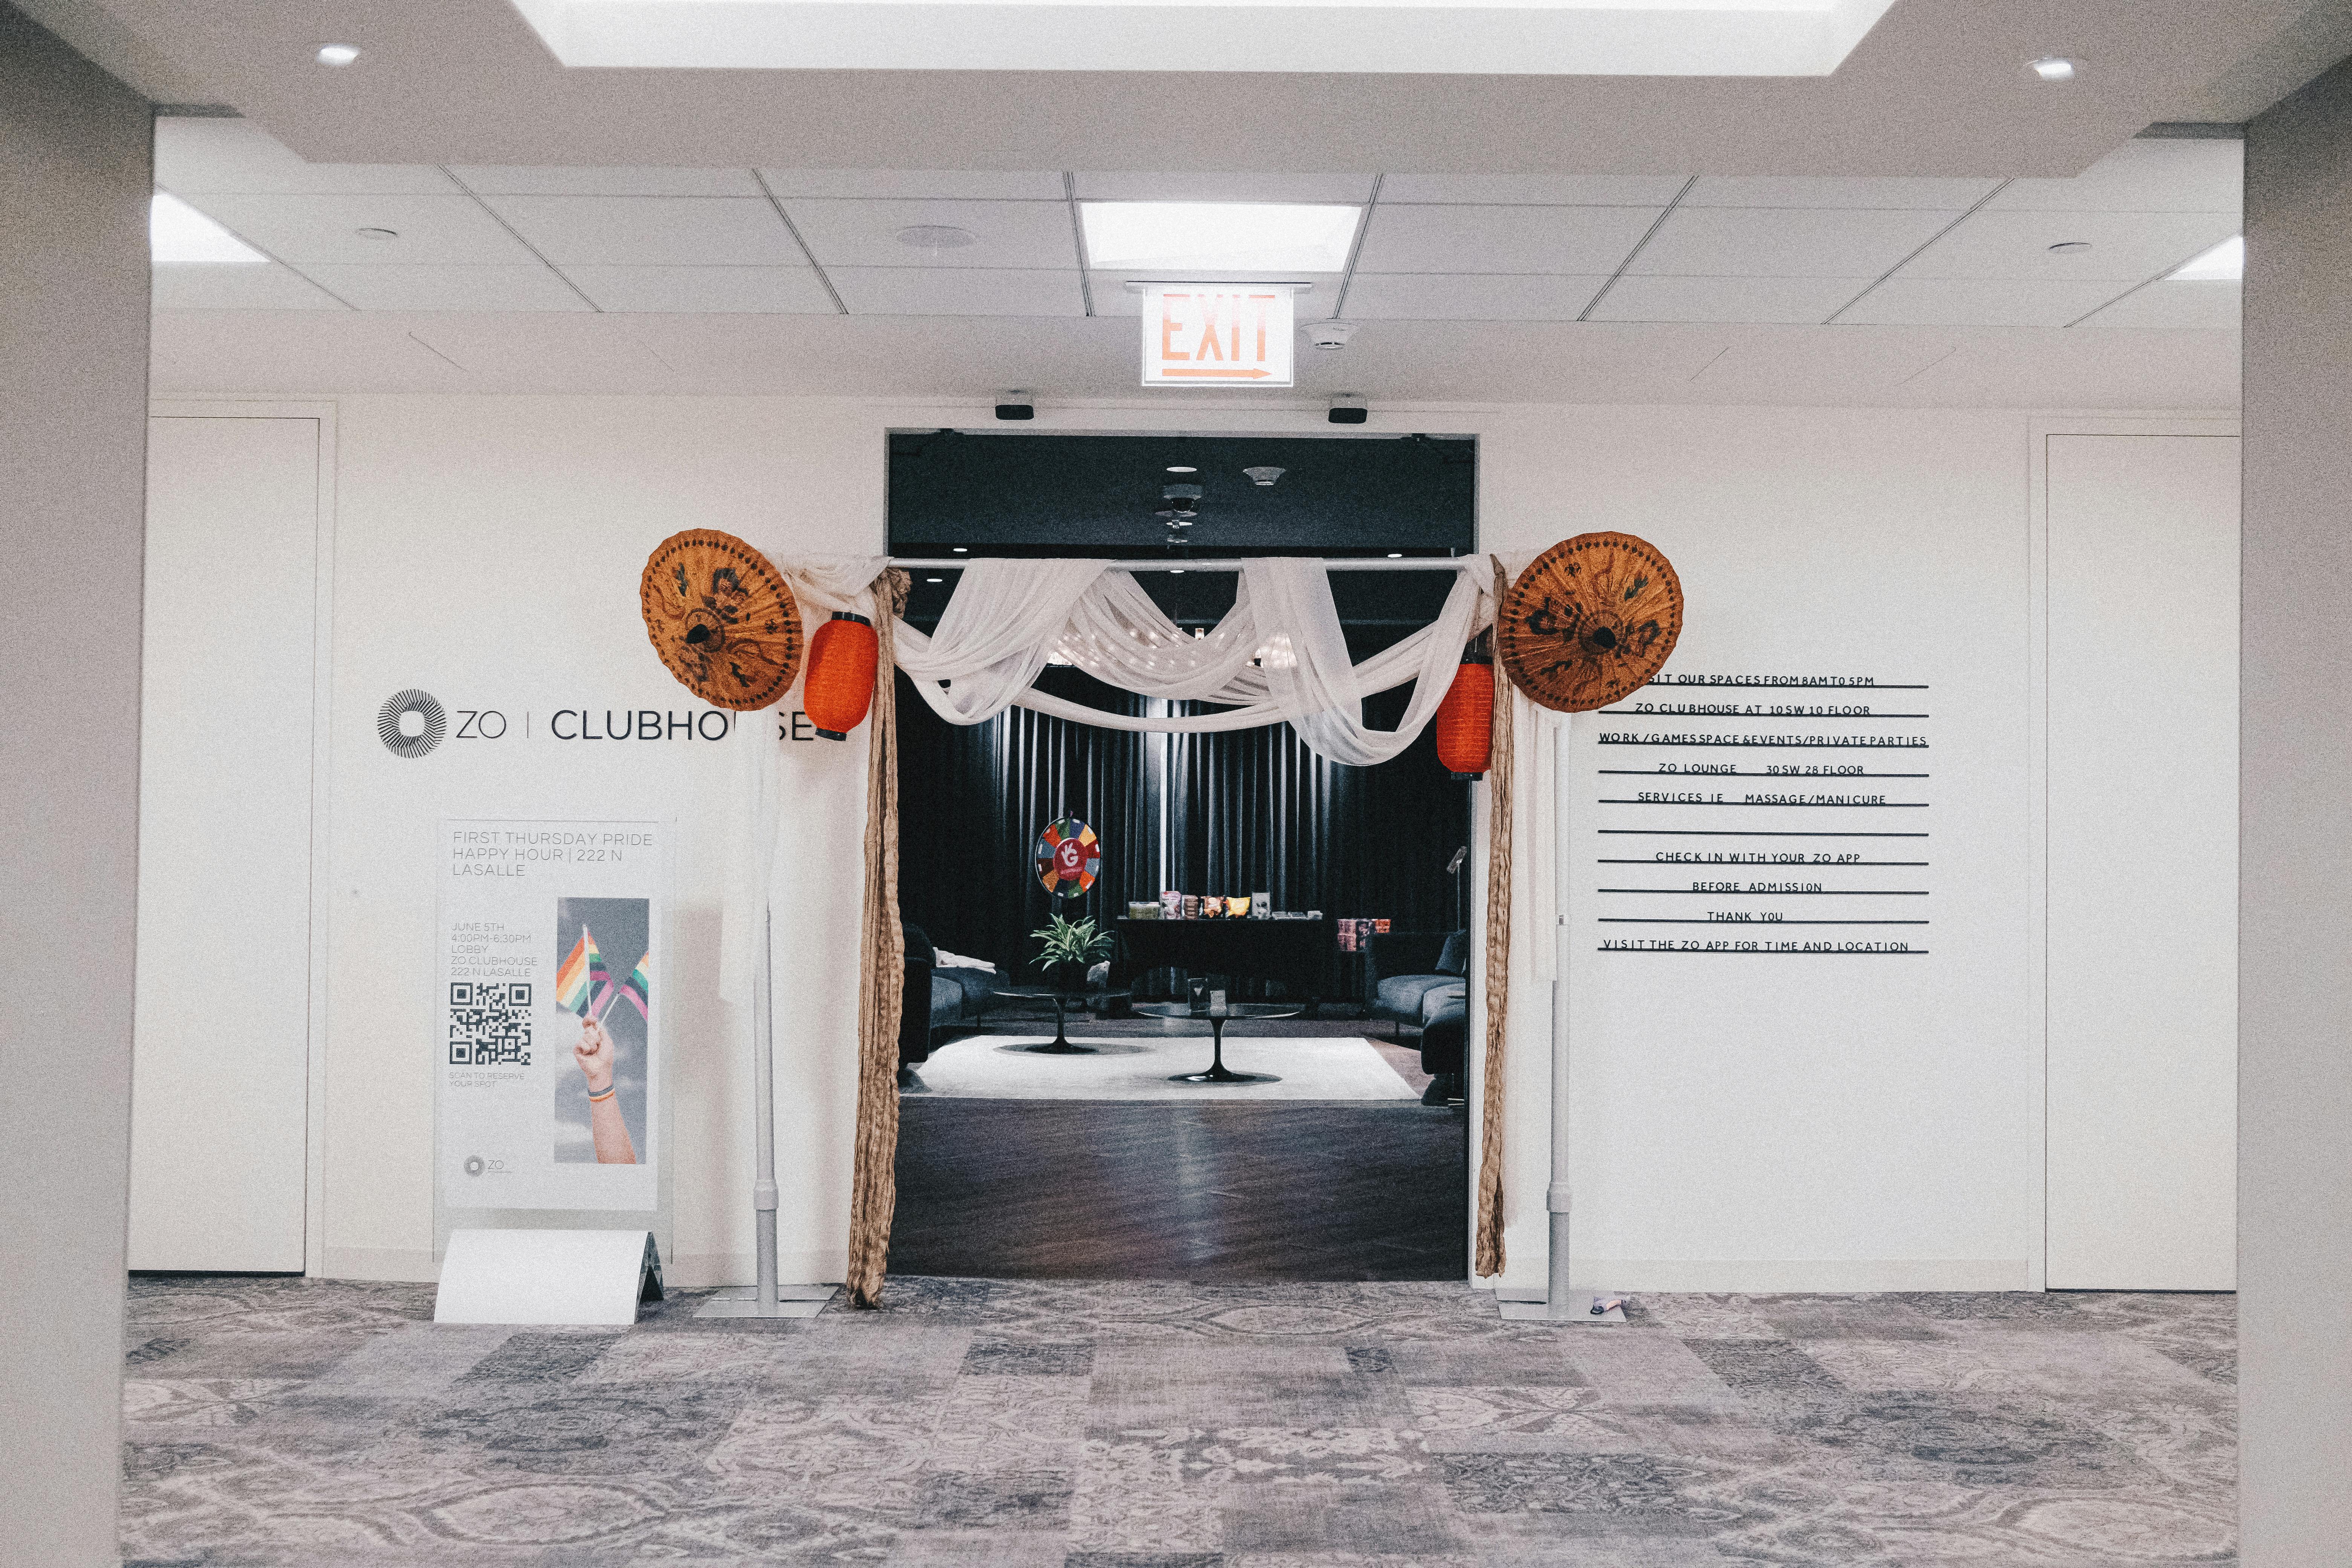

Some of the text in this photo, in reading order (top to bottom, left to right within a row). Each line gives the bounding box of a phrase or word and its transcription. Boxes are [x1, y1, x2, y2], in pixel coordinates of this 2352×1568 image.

[1162, 294, 1275, 361] EXIT
[1677, 674, 1705, 684] OUR
[1710, 674, 1760, 684] SPACES
[1764, 675, 1798, 685] FROM
[1802, 676, 1827, 685] 8AM
[1849, 677, 1874, 686] 5PM
[1635, 703, 1654, 712] ZO
[1659, 703, 1739, 712] CLUBHOUSE
[1746, 705, 1761, 713] AT
[1828, 706, 1870, 714] FLOOR
[456, 710, 506, 739] ZO
[1659, 763, 1677, 772] ZO
[1683, 764, 1736, 772] LOUNGE
[1823, 765, 1863, 774] FLOOR
[1638, 792, 1702, 801] SERVICES
[1711, 793, 1722, 802] IE
[453, 831, 652, 846] FIRST THURSDAY PRIDE
[453, 848, 509, 859] HAPPY
[515, 848, 563, 861] HOUR
[577, 849, 605, 861] 222
[611, 849, 622, 862] N
[1655, 852, 1860, 862] CHECK IN WITH YOUR ZO APP
[453, 864, 525, 876] LASALLE
[1692, 882, 1740, 891] BEFORE
[1707, 912, 1752, 920] THANK
[452, 923, 504, 931] JUNE 5TH
[452, 945, 488, 954] LOBBY
[1603, 939, 1908, 951] VISIT THE ZO APP FOR TIME AND LOCATION
[451, 956, 538, 965] ZO CLUBHOUSE
[451, 967, 470, 975] 222
[484, 968, 531, 977] LASALLE
[488, 1160, 504, 1170] ZO
